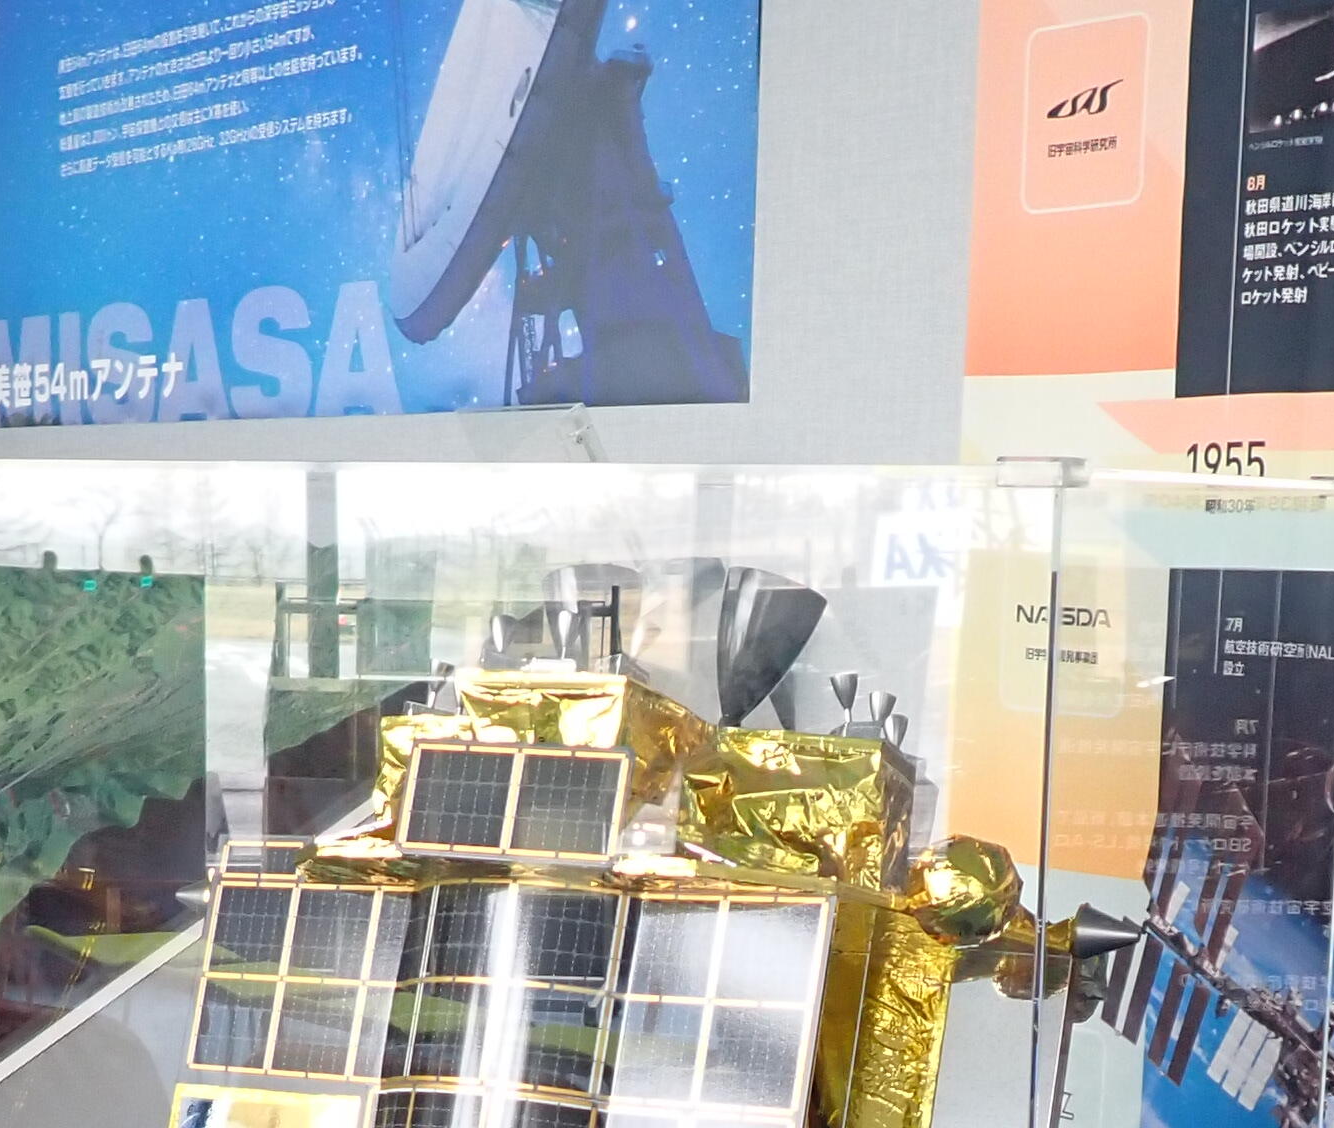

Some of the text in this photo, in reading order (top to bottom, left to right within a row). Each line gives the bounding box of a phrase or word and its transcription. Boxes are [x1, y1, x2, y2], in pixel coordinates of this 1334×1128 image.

[1246, 174, 1266, 191] 8月
[1241, 286, 1309, 305] ロケット発射
[1186, 440, 1266, 478] 1955
[1224, 616, 1244, 633] 7月
[1223, 660, 1245, 677] 設立
